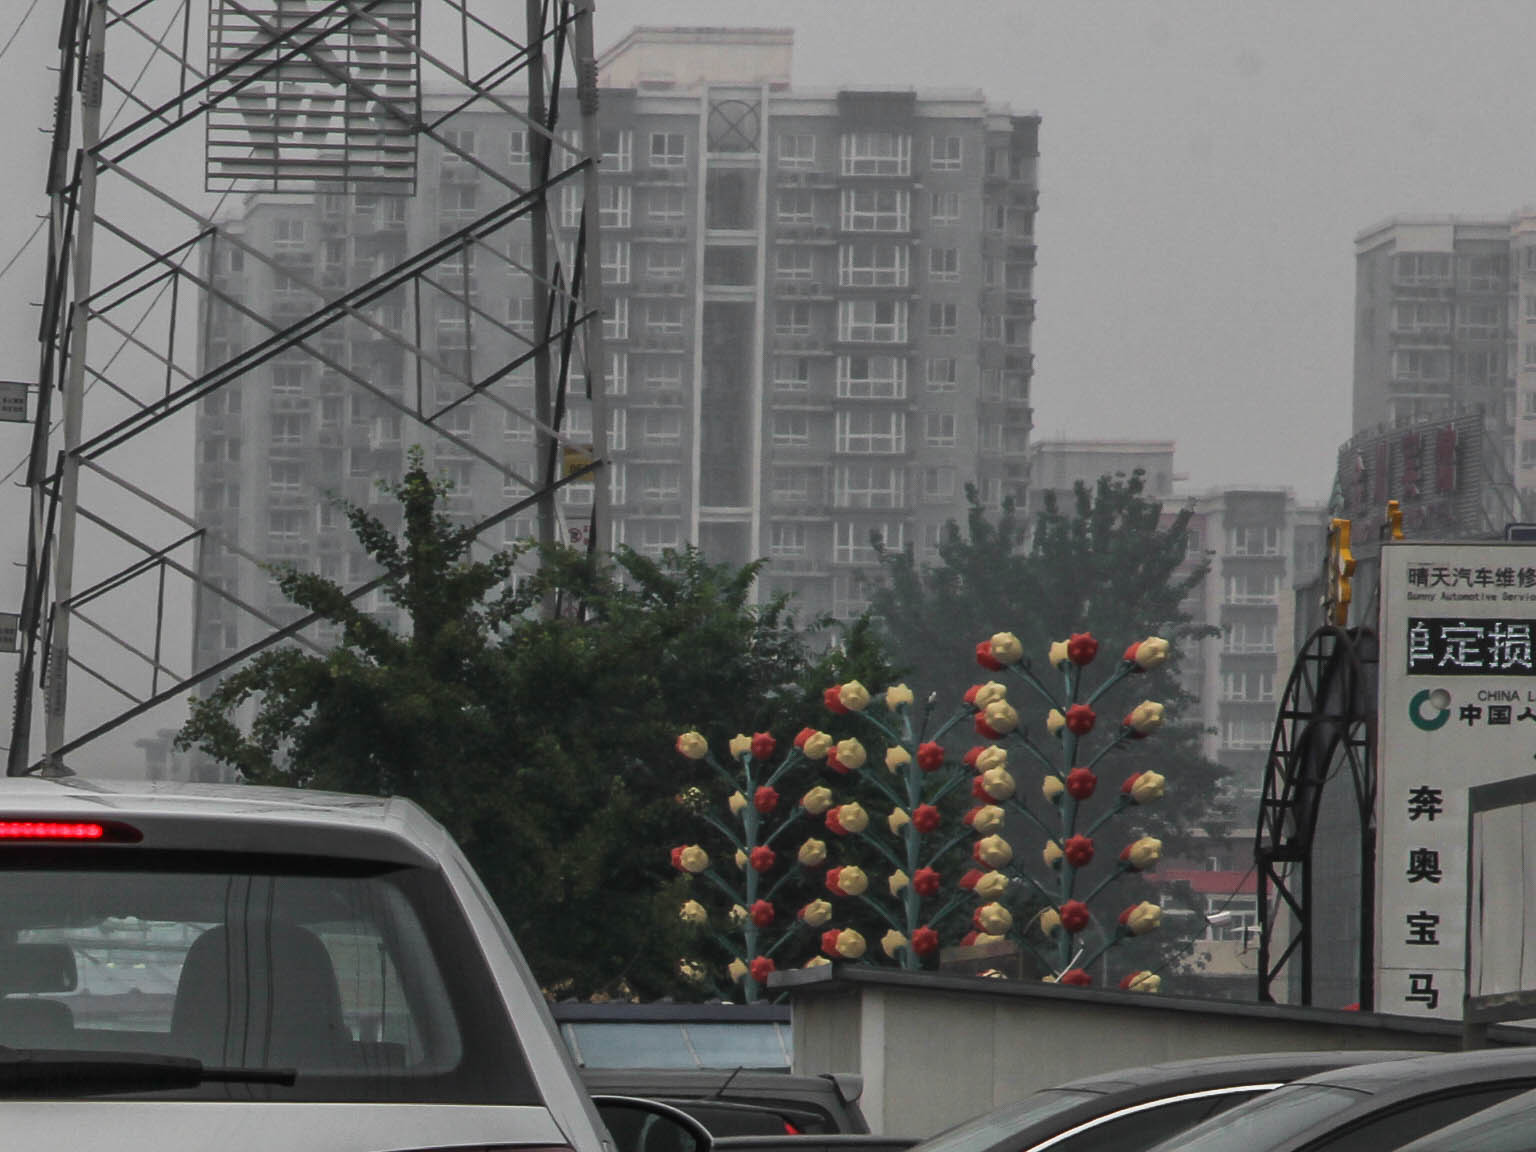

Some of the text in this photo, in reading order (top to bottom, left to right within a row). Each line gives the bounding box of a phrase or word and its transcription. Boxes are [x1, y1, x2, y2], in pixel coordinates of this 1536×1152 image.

[1407, 567, 1536, 589] 晴天汽车维修
[1478, 689, 1520, 702] CHINA
[1405, 786, 1443, 1009] 奔奥宝马
